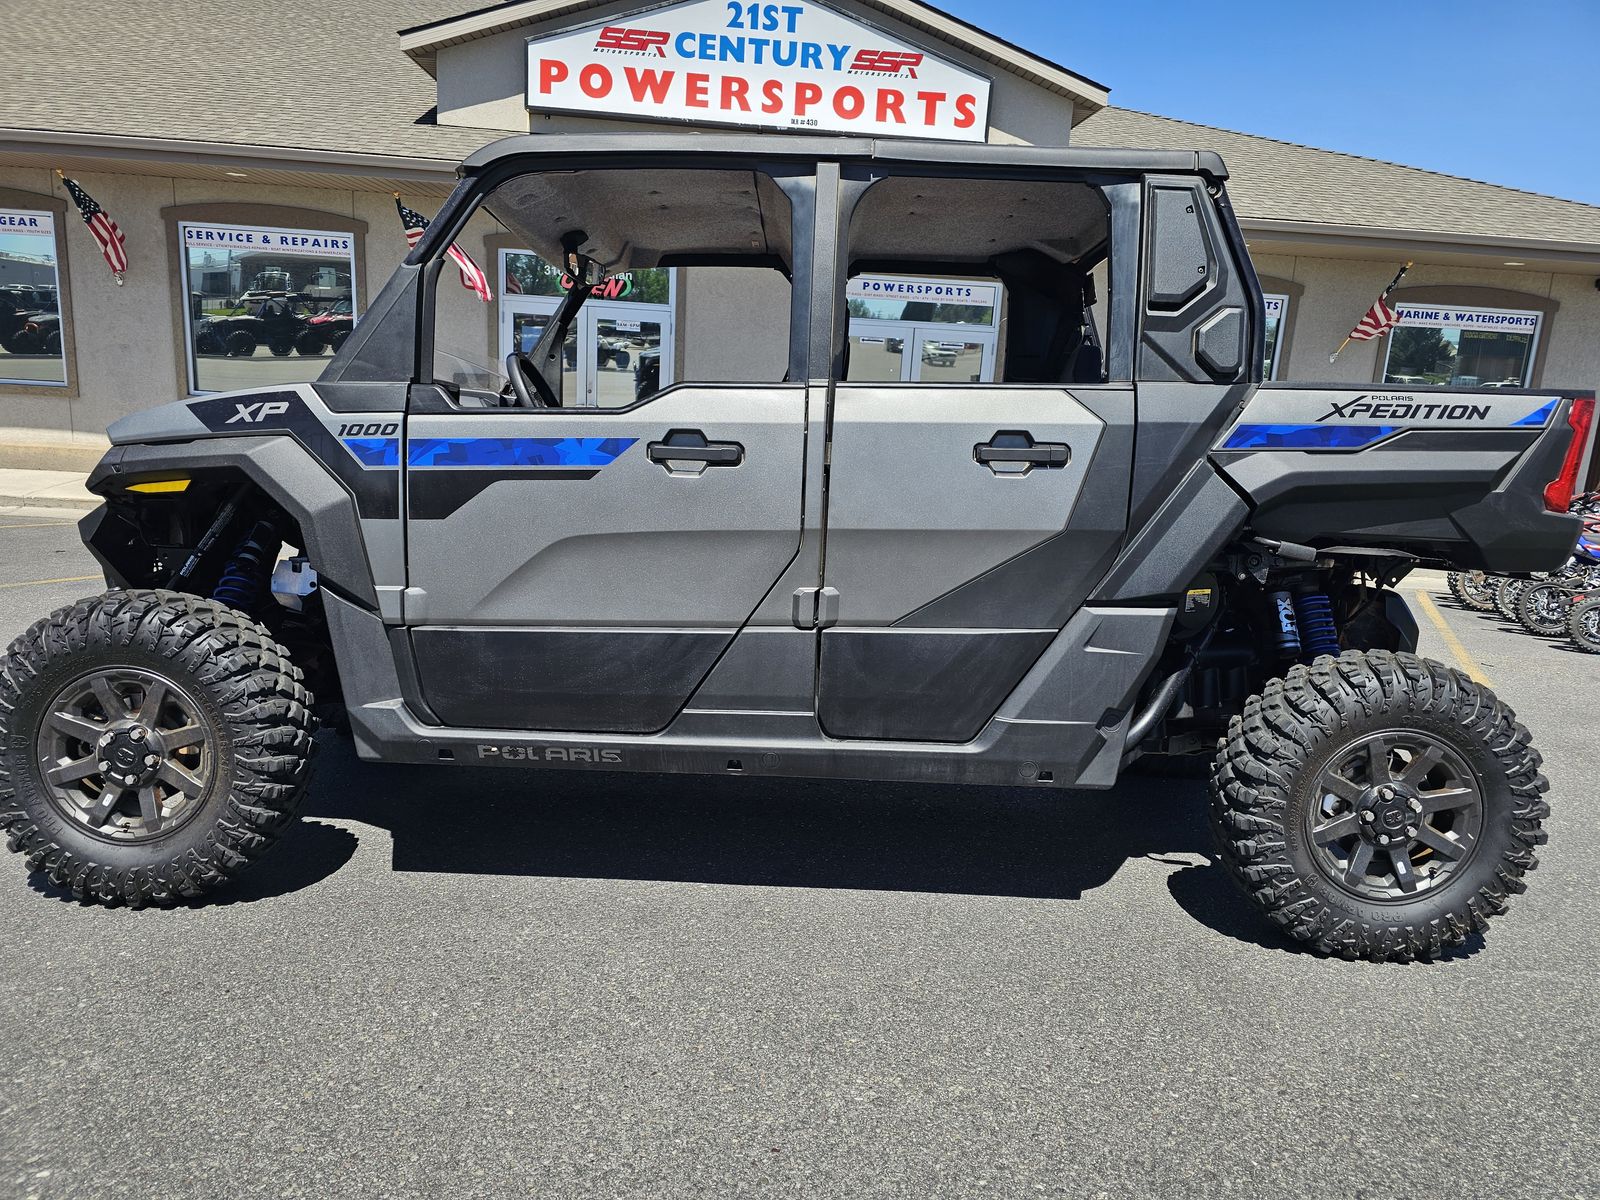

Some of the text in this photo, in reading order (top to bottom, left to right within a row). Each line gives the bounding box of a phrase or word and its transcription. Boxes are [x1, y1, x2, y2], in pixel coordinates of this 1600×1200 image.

[726, 1, 804, 34] 21ST
[595, 26, 671, 58] SSR
[593, 48, 657, 57] MOTORSPORTS
[674, 32, 852, 72] CENTURY
[850, 49, 924, 79] SSR
[847, 70, 909, 79] MOTORSPORTS
[539, 58, 977, 129] POWERSPORTS
[0, 216, 38, 227] GEAR
[187, 230, 348, 249] SERVICE & REPAIRS
[862, 282, 972, 297] POWERSPORTS
[1266, 301, 1279, 310] TS
[1397, 310, 1536, 326] MARINE & WATERSPORTS
[224, 401, 290, 424] XP
[1315, 395, 1492, 423] XPEDITION
[337, 423, 399, 437] 1000
[1276, 597, 1298, 635] FOX
[476, 744, 623, 763] POLARIS
